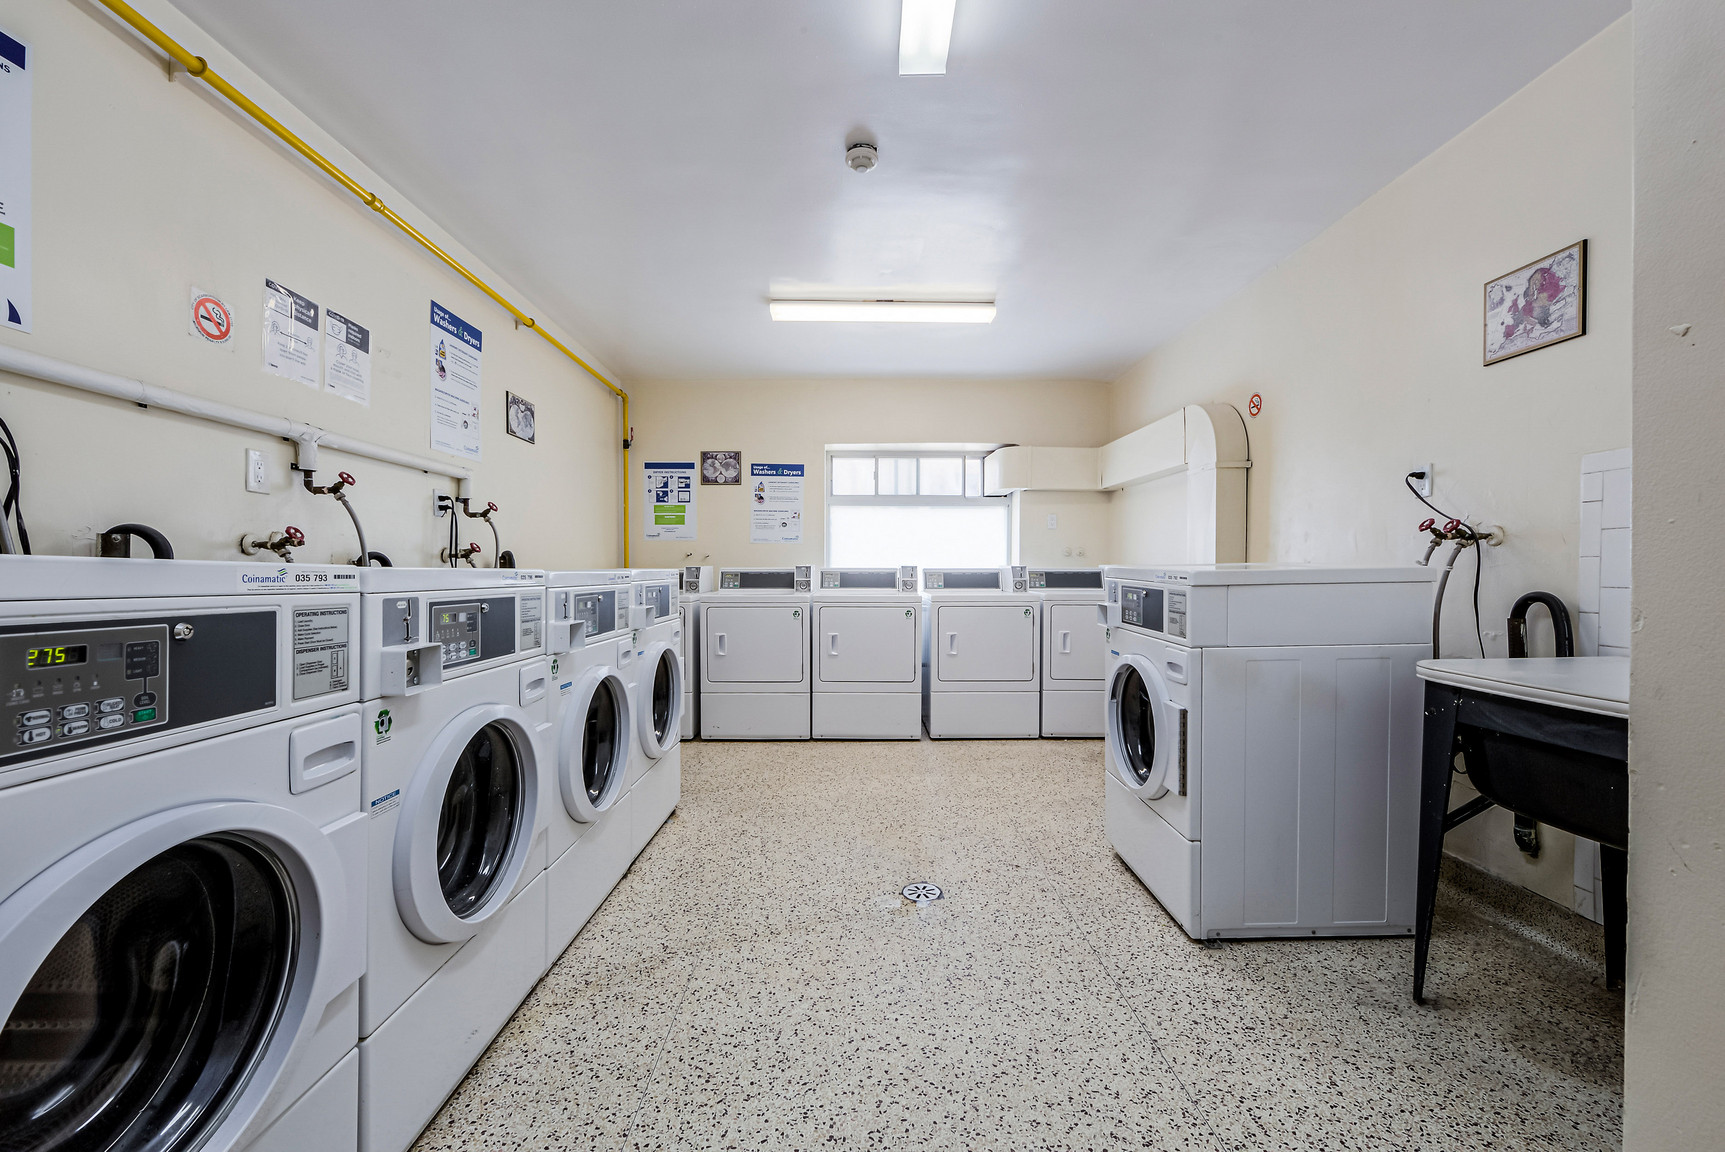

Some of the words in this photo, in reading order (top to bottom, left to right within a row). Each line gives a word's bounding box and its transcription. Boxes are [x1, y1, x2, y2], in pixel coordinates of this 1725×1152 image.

[434, 313, 457, 334] Washers
[458, 326, 463, 337] &
[464, 332, 480, 348] Dryers
[242, 574, 286, 584] Coinamatic
